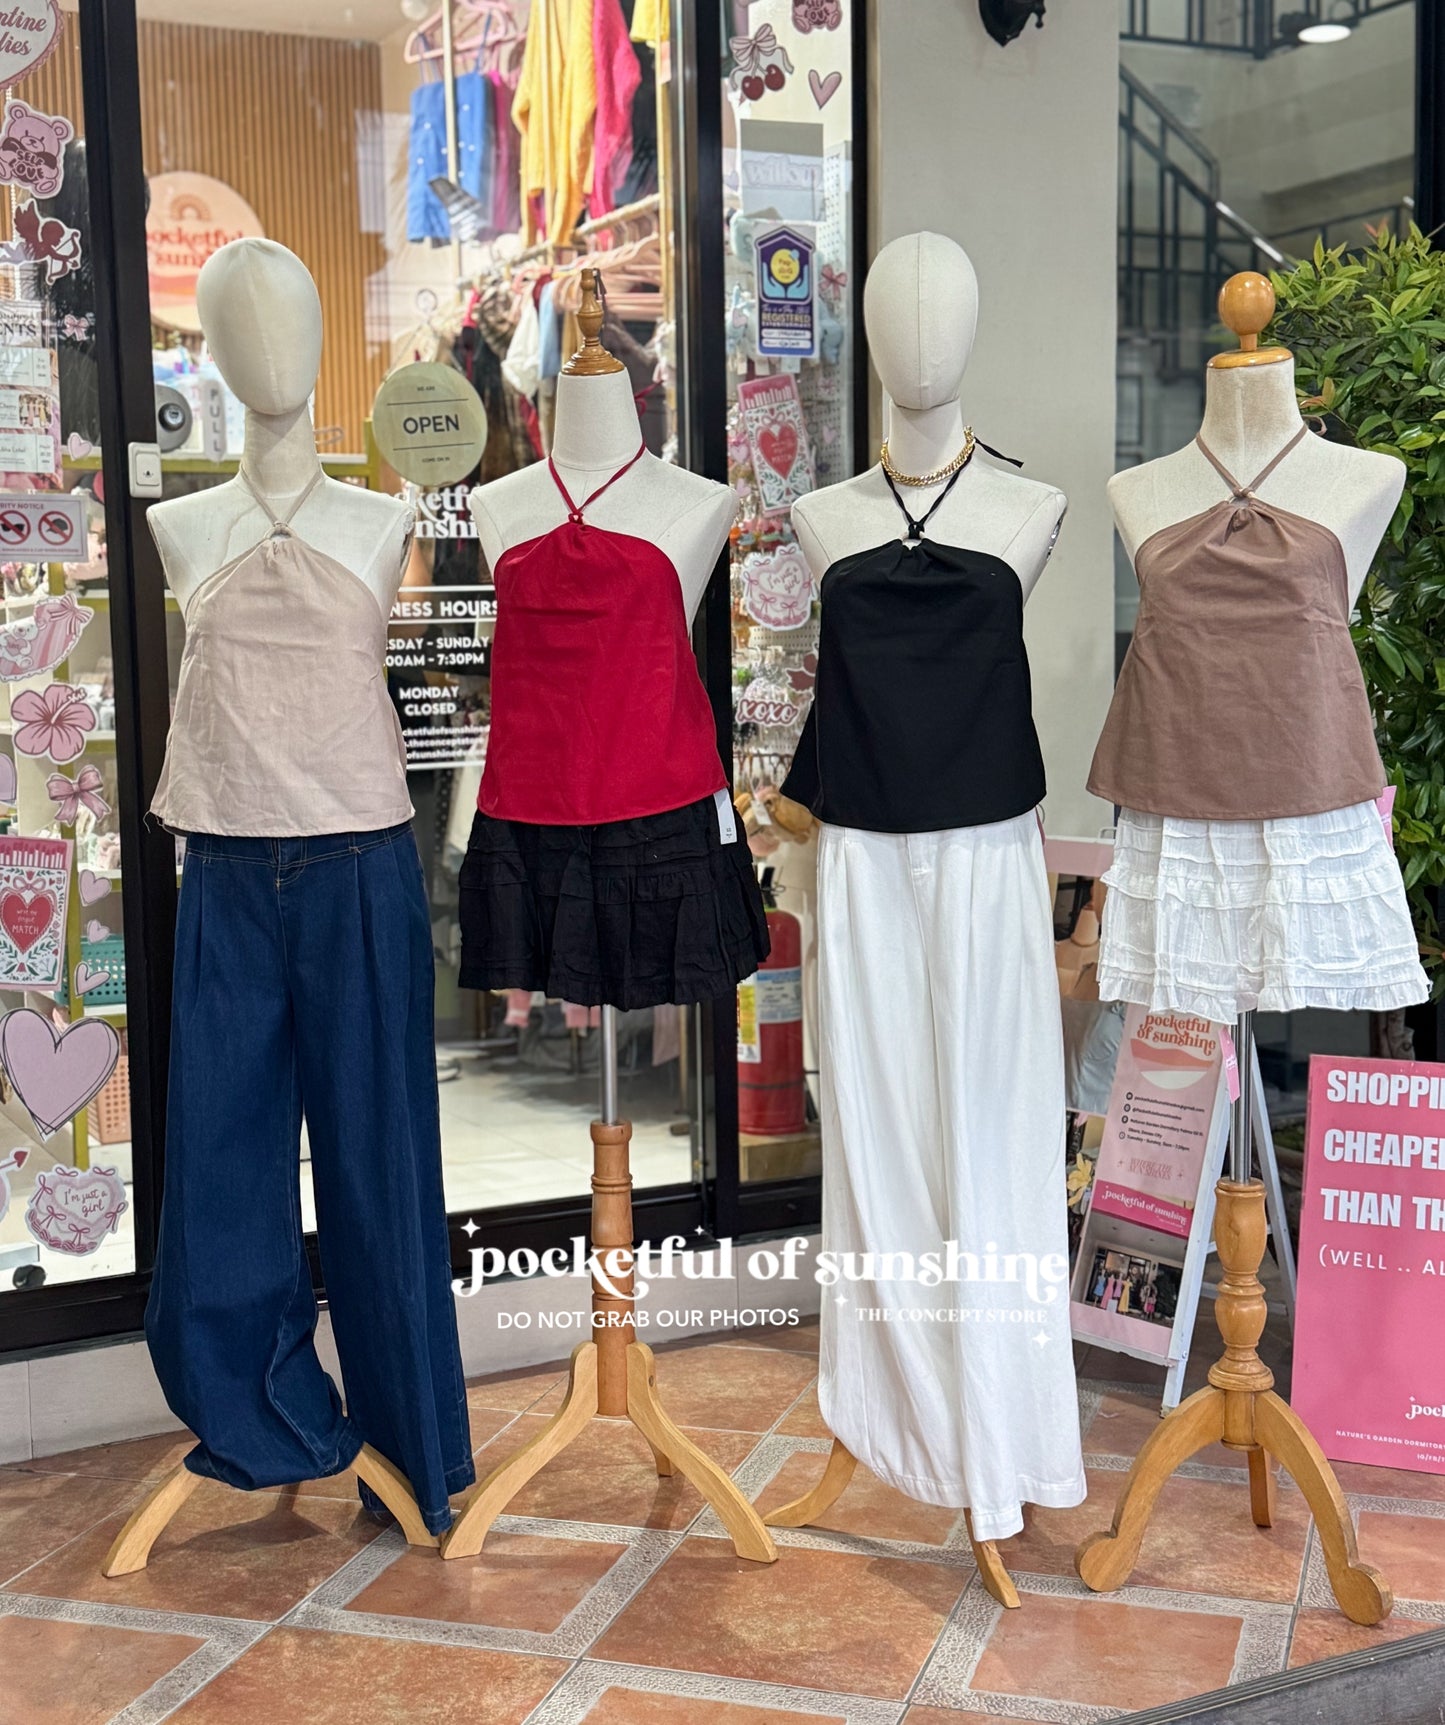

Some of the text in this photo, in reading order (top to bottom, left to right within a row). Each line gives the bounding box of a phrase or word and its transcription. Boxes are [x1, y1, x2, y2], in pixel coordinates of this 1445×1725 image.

[17, 150, 44, 166] SELF
[9, 158, 45, 179] LOVE
[0, 322, 36, 336] NTS
[403, 414, 460, 435] OPEN
[386, 638, 424, 650] SDAY
[437, 637, 489, 649] SUNDAY
[437, 653, 484, 666] 7:30PM
[399, 686, 459, 700] MONDAY
[404, 702, 457, 716] CLOSED
[12, 924, 39, 935] MATCH
[1140, 1014, 1211, 1036] pocketful
[1137, 1026, 1216, 1056] of sunshine
[64, 1189, 80, 1205] I'm
[81, 1189, 99, 1203] just
[1102, 1190, 1145, 1208] pocketful
[1145, 1203, 1155, 1212] of
[82, 1199, 104, 1217] girl
[1320, 1188, 1402, 1228] THAN
[1319, 1244, 1387, 1270] (WELL
[1335, 1430, 1371, 1440] NATURE'S
[1372, 1434, 1402, 1444] GARDEN
